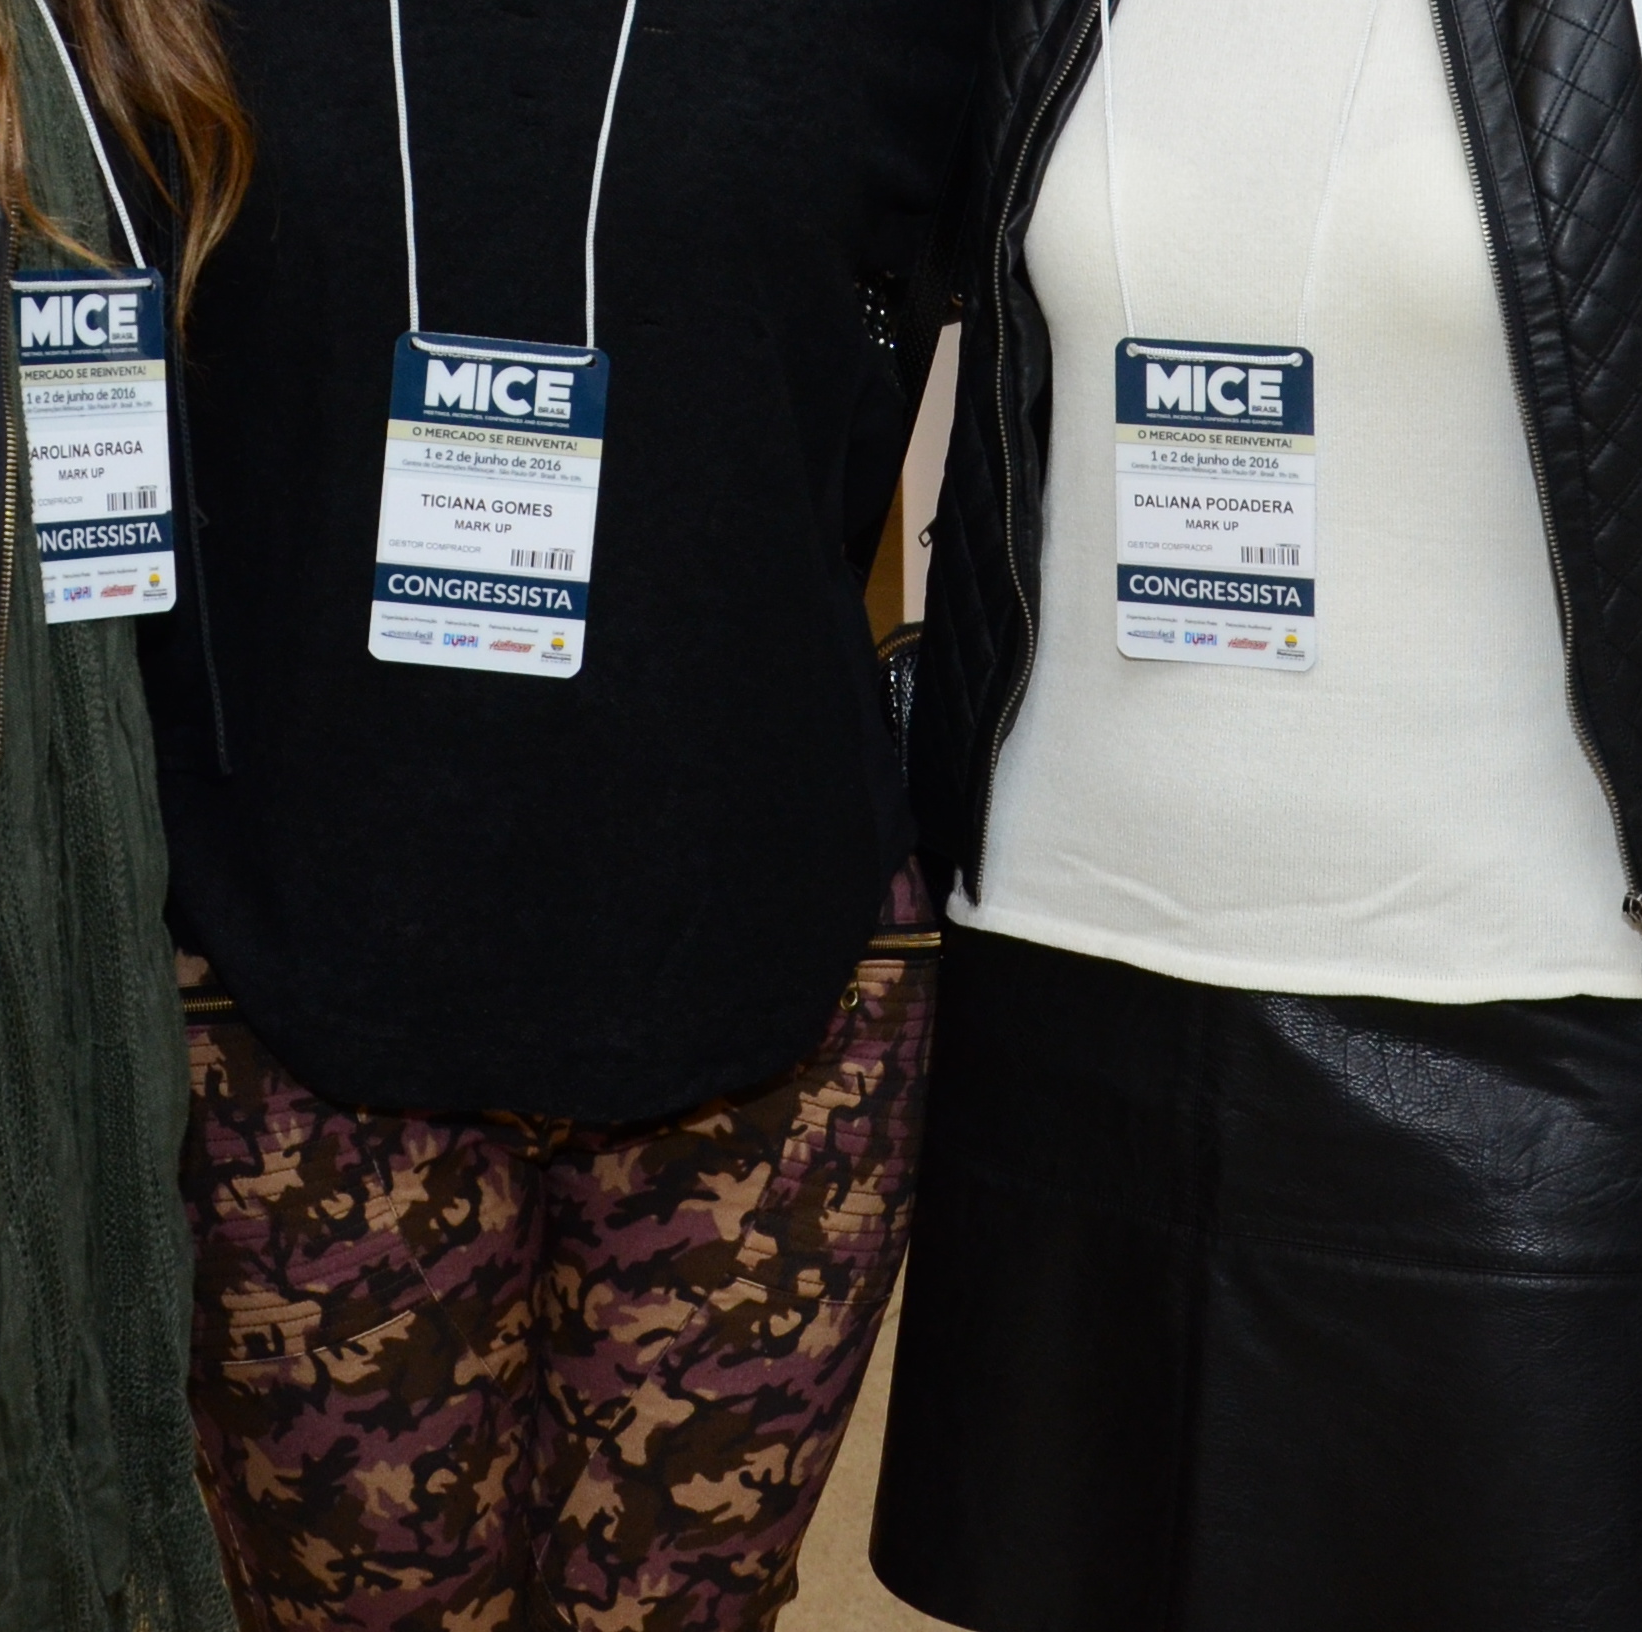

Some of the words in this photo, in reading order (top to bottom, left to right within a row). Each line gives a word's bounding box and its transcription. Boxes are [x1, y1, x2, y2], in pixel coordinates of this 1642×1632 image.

[21, 293, 138, 347] MICE
[25, 369, 74, 381] MERCADO
[77, 368, 88, 379] SE
[90, 366, 147, 378] REINVENTA!
[26, 393, 32, 405] 1
[35, 394, 42, 405] e
[43, 391, 50, 405] 2
[52, 390, 65, 404] de
[66, 388, 95, 405] junho
[96, 387, 109, 402] de
[110, 387, 136, 400] 2016
[424, 359, 574, 419] MICE
[1146, 362, 1283, 417] MICE
[538, 406, 567, 416] BRASIL
[1251, 405, 1280, 414] BRASIL
[412, 426, 422, 437] O
[425, 427, 486, 443] MERCADO
[489, 433, 503, 444] SE
[507, 435, 578, 451] REINVENTA!
[1138, 430, 1147, 440] O
[1149, 430, 1206, 444] MERCADO
[1209, 434, 1223, 445] SE
[1225, 435, 1293, 449] REINVENTA!
[30, 444, 92, 461] AROLINA
[94, 440, 144, 457] GRAGA
[425, 448, 432, 460] 1
[435, 451, 443, 460] e
[446, 449, 454, 461] 2
[457, 450, 471, 463] de
[473, 451, 508, 467] junho
[511, 455, 526, 468] de
[530, 457, 562, 472] 2016
[1151, 450, 1157, 462] 1
[1160, 453, 1168, 463] e
[1170, 451, 1178, 463] 2
[1180, 452, 1195, 464] de
[1196, 453, 1229, 467] junho
[1232, 454, 1247, 467] de
[1249, 456, 1279, 469] 2016
[58, 468, 88, 481] MARK
[91, 467, 105, 479] UP
[421, 493, 486, 512] TICIANA
[491, 499, 553, 518] GOMES
[1134, 494, 1202, 510] DALIANA
[1206, 497, 1294, 514] PODADERA
[454, 519, 491, 532] MARK
[495, 523, 512, 534] UP
[1185, 519, 1220, 531] MARK
[1223, 521, 1239, 531] UP
[37, 521, 163, 553] NGRESSISTA
[388, 538, 424, 550] GESTOR
[426, 541, 481, 554] COMPRADOR
[1127, 540, 1160, 550] GESTOR
[1162, 541, 1213, 552] COMPRADOR
[387, 573, 573, 611] CONGRESSISTA
[1129, 574, 1302, 608] CONGRESSISTA
